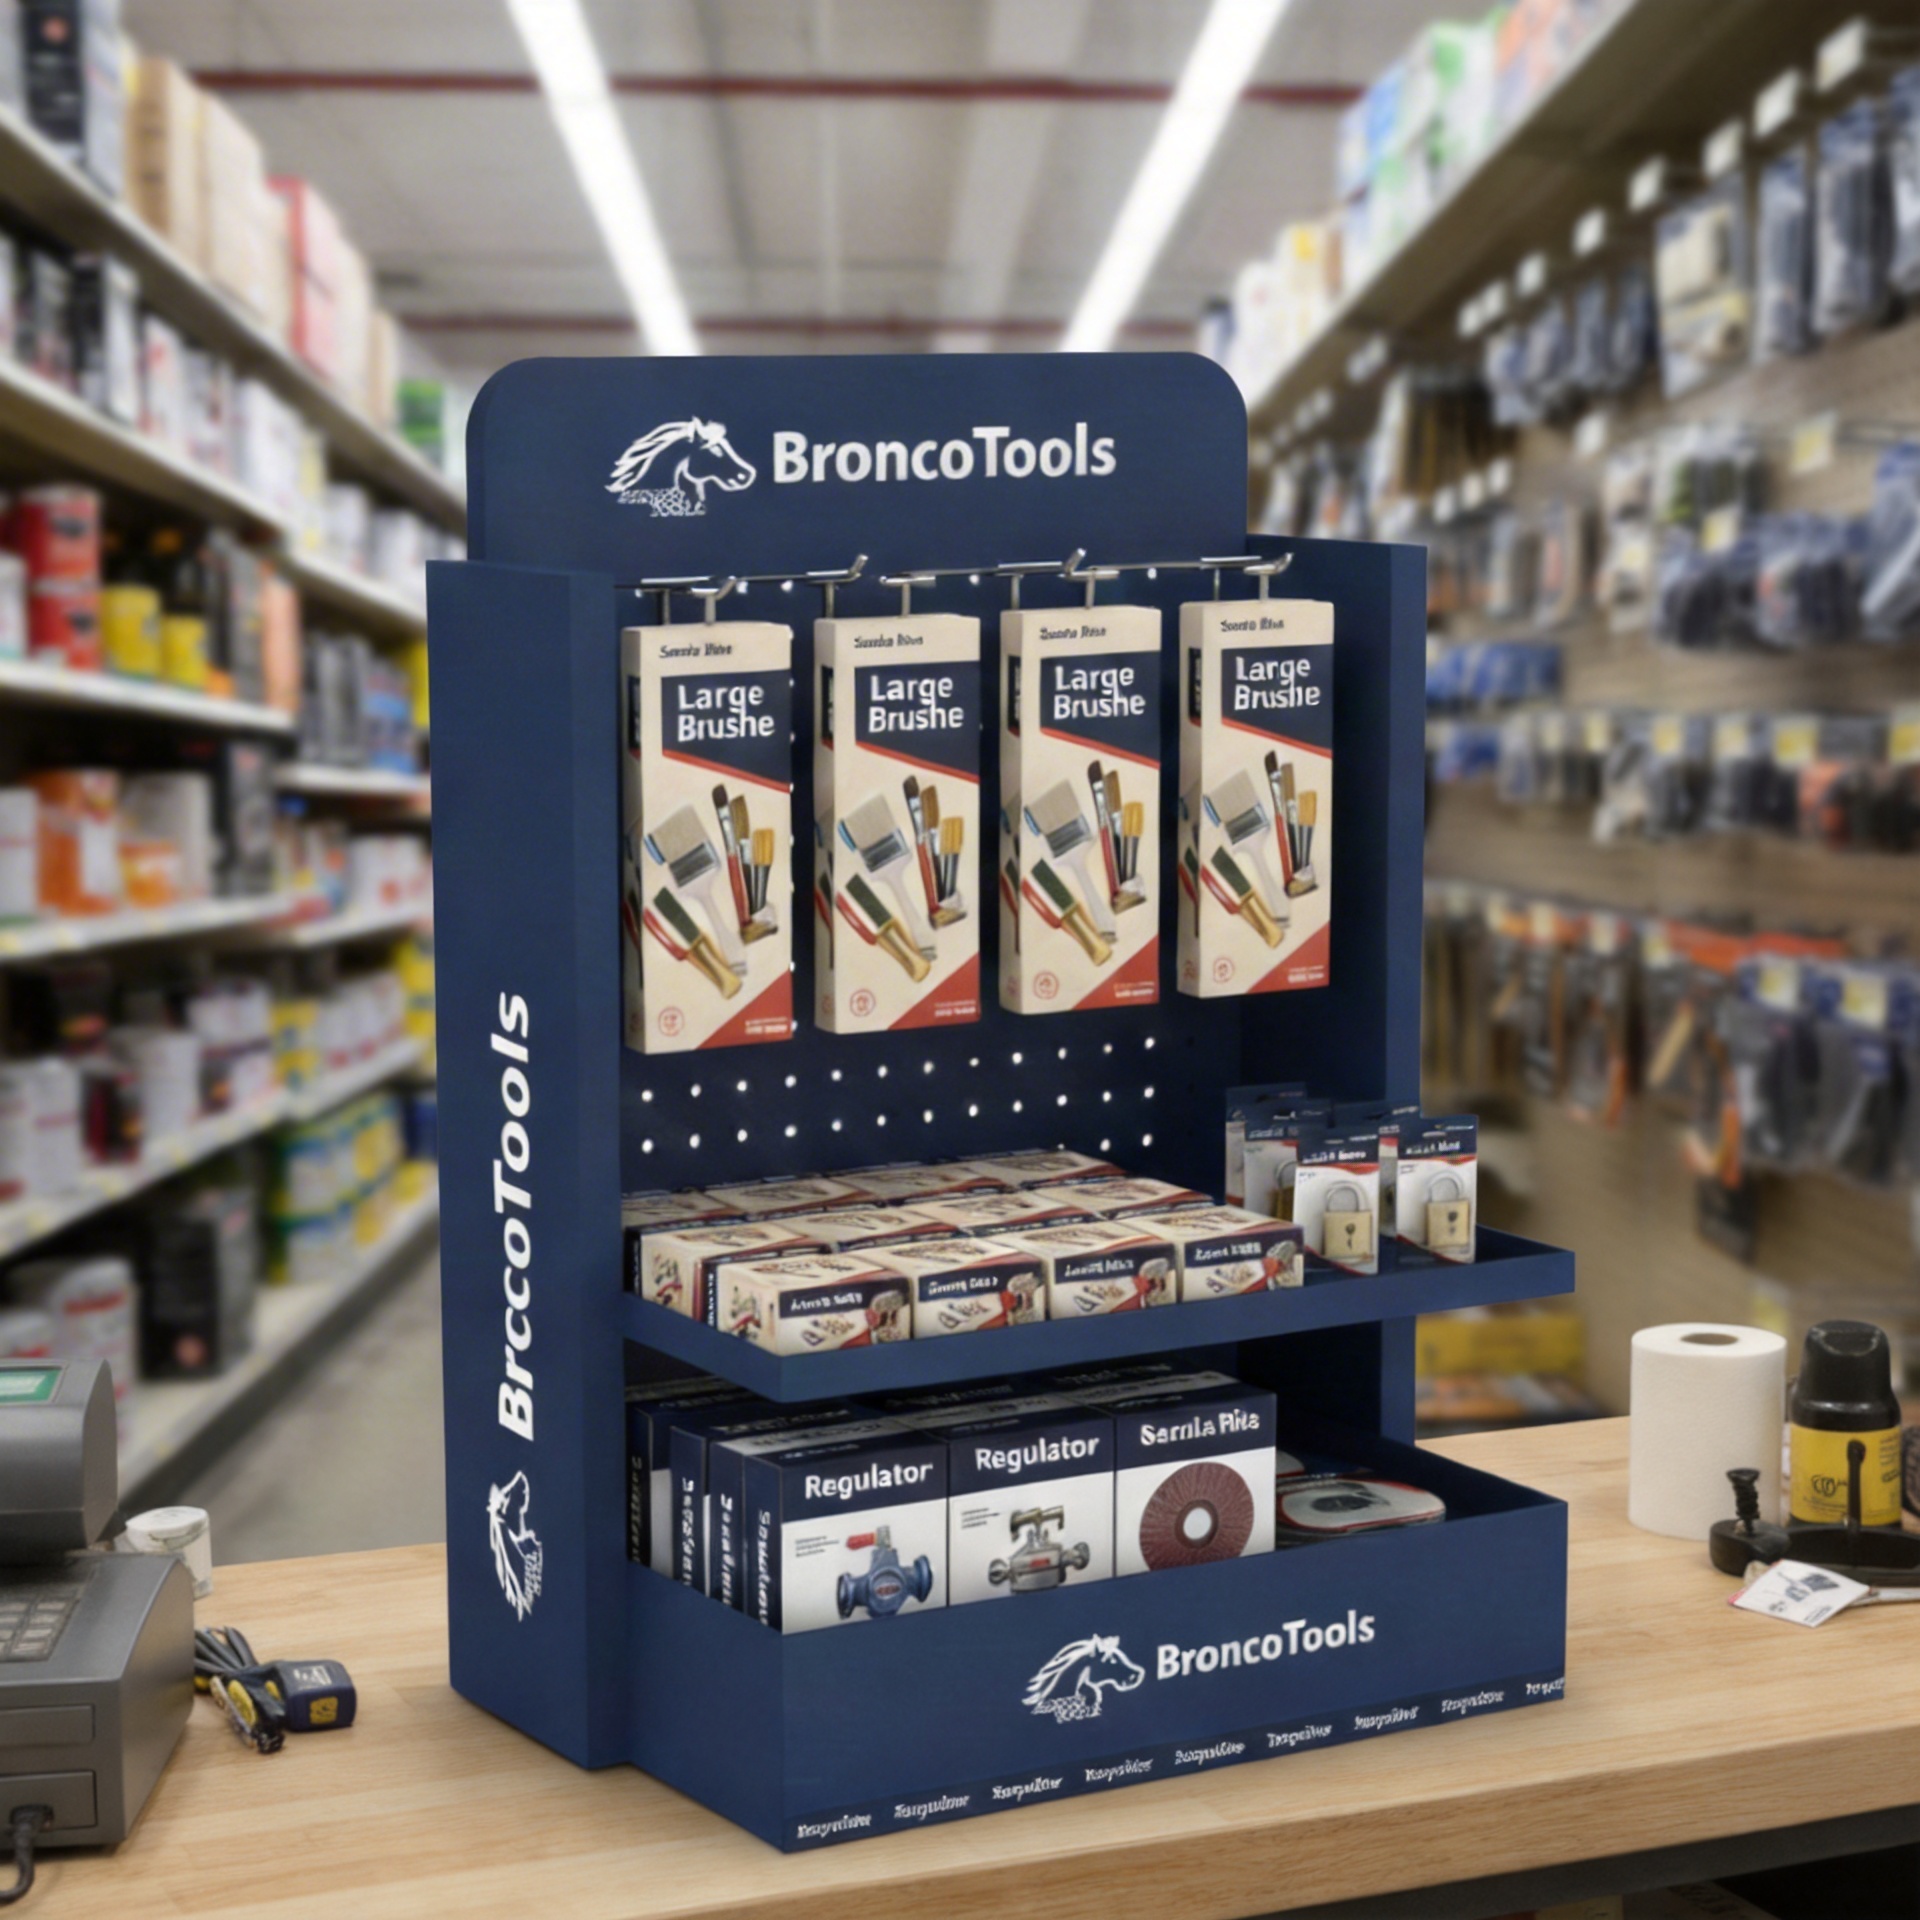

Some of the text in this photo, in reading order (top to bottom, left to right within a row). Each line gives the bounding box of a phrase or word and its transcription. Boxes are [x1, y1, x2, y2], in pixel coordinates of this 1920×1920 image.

[773, 421, 1117, 484] BroncoTools
[1054, 665, 1135, 696] Large
[1236, 656, 1311, 685] Large
[678, 684, 764, 713] Large
[870, 675, 953, 704] Large
[975, 1437, 1099, 1473] Regulator
[805, 1463, 934, 1500] Regulator
[1157, 1609, 1375, 1680] BroncoTools
